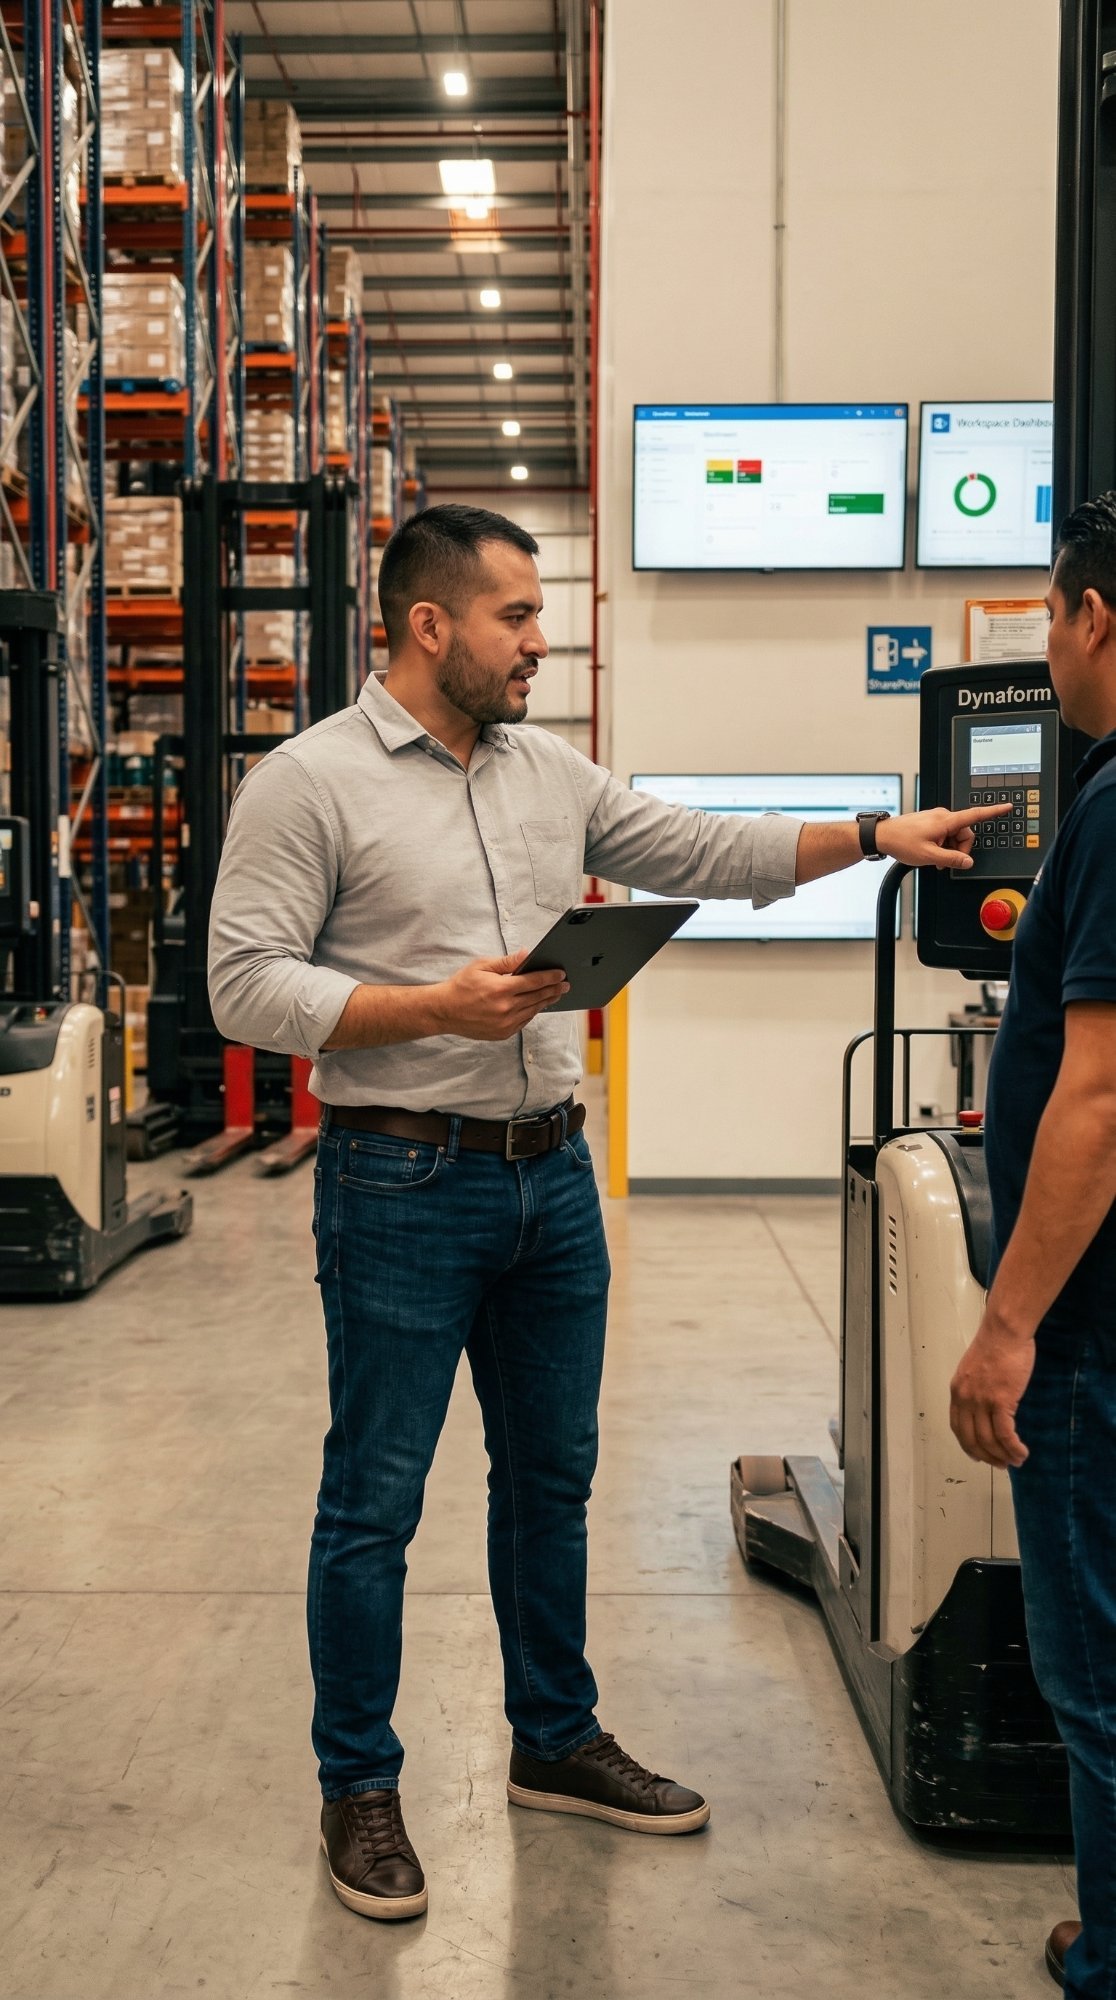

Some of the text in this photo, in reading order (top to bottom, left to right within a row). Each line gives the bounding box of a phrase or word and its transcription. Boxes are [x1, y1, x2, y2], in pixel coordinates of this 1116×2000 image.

[956, 418, 1010, 430] Workspace
[868, 678, 920, 691] SharePoin
[958, 686, 1052, 709] Dynaform
[986, 794, 992, 802] 2
[1001, 793, 1006, 801] 3
